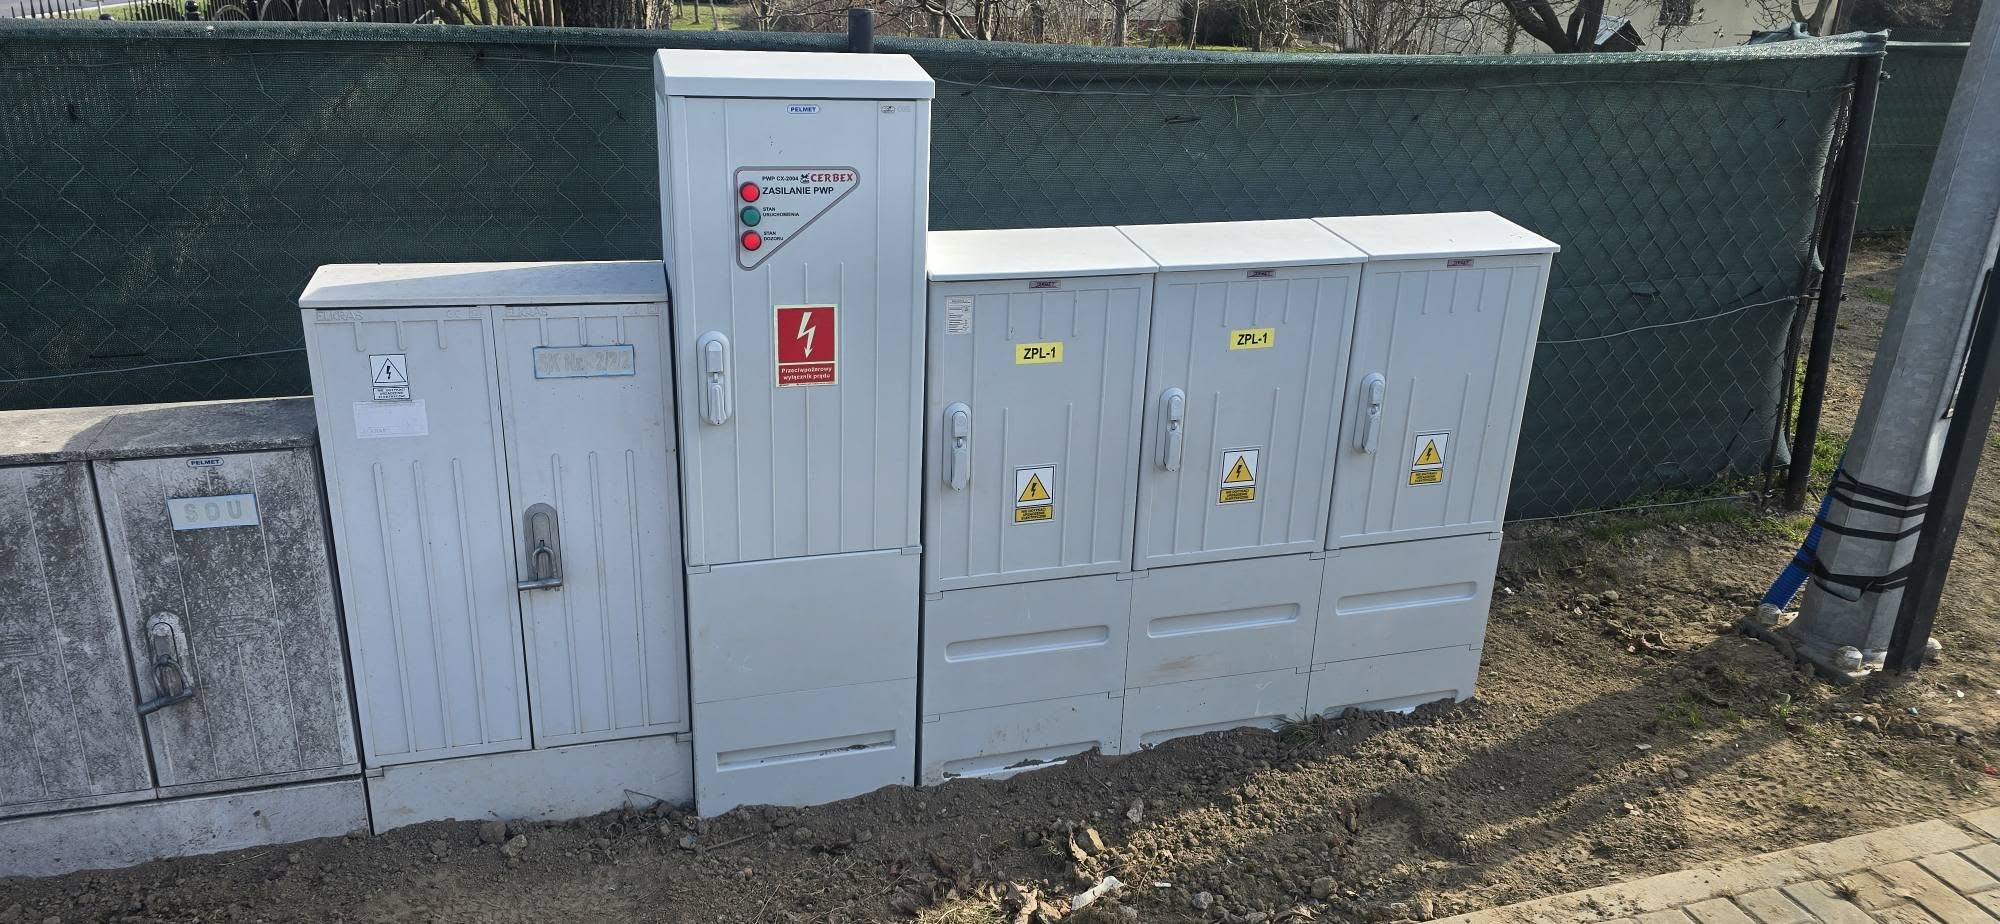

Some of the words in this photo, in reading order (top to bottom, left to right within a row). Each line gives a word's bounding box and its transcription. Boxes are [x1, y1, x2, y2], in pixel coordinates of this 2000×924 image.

[810, 173, 854, 183] CERBEX
[762, 186, 811, 195] ZASILANIE
[813, 186, 834, 195] PWP
[1237, 332, 1268, 346] ZPL-1
[1023, 346, 1056, 360] ZPL-1
